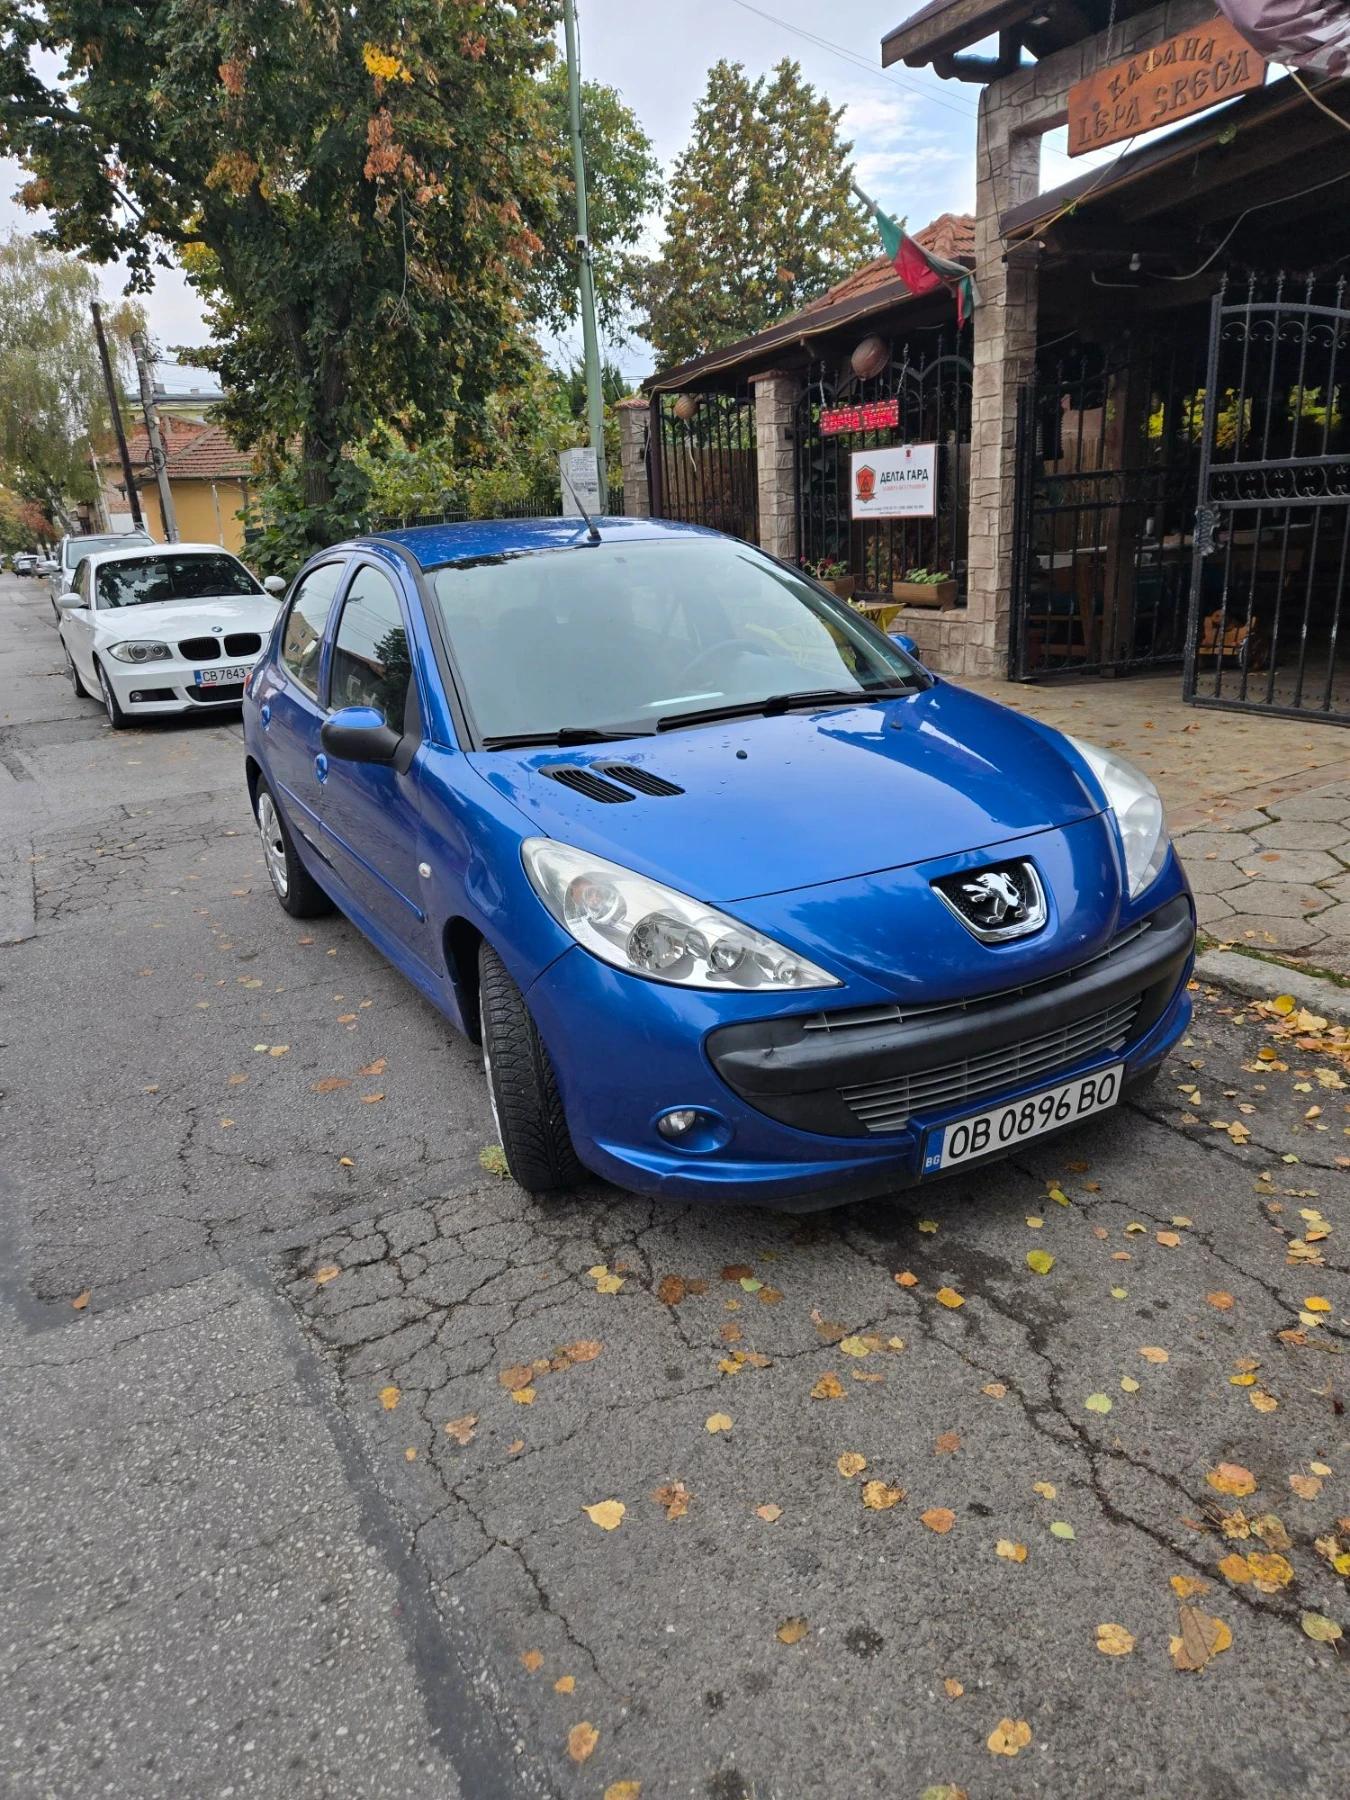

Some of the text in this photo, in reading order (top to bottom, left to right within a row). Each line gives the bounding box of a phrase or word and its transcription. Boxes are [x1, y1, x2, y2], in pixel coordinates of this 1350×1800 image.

[880, 468, 929, 484] ДЕЛТА ГАРД
[202, 671, 218, 682] CB
[219, 668, 246, 680] 7843
[949, 1073, 1116, 1159] OB 0896 BO
[925, 1154, 940, 1168] BG
